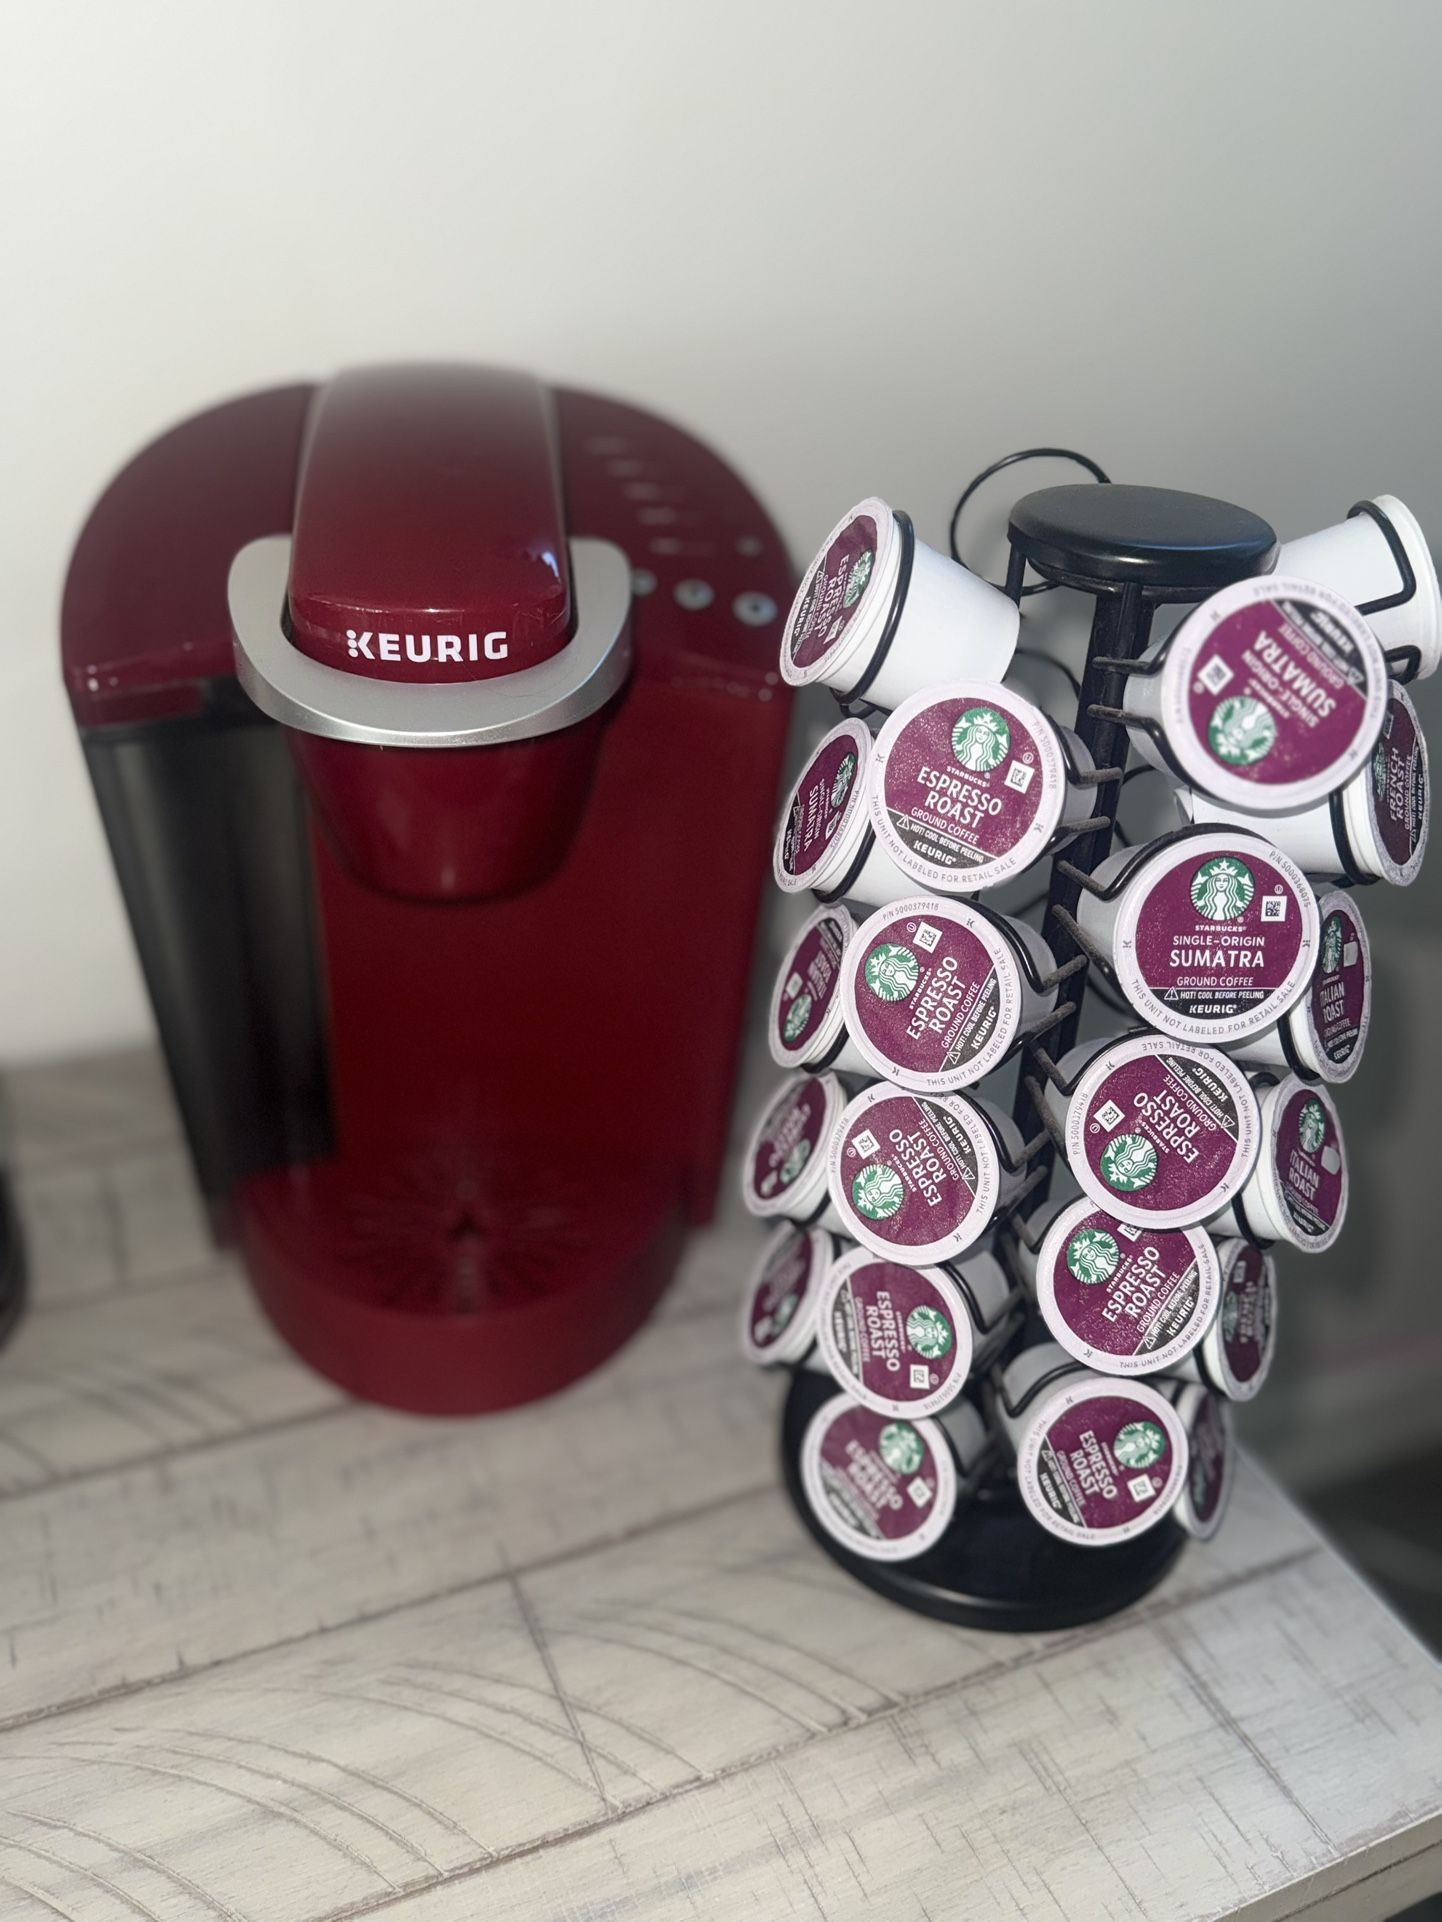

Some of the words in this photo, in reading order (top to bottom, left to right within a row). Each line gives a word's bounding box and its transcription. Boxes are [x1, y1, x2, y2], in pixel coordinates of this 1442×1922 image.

[814, 576, 837, 631] ROAST
[818, 553, 850, 638] ESPRESSO
[794, 596, 811, 637] KEURIG
[346, 630, 508, 662] KEURIG
[1278, 622, 1311, 655] COFFEE
[1253, 631, 1337, 717] SUMATRA
[1306, 651, 1345, 690] GROUND
[1242, 649, 1320, 728] SINGLE-ORIGIN
[917, 767, 1002, 816] ESPRESSO
[946, 766, 988, 787] STARBUCKS
[1389, 747, 1399, 821] FRENCH
[1395, 757, 1405, 820] ROAST
[804, 785, 819, 851] SUMATRA
[911, 807, 947, 830] GROUND
[948, 823, 979, 844] COFFEE
[924, 791, 984, 828] ROAST
[872, 796, 882, 817] THIS
[877, 817, 891, 840] UNIT
[889, 840, 903, 856] NOT
[902, 855, 939, 880] LABELED
[941, 873, 960, 882] FOR
[962, 870, 994, 883] RETAIL
[993, 857, 1016, 875] SALE
[910, 823, 925, 837] HOT!
[924, 829, 940, 843] COOL
[939, 836, 961, 853] BEFORE
[960, 844, 984, 863] PEELING
[914, 840, 954, 865] KEURIG
[1269, 850, 1283, 865] P/N
[882, 911, 894, 921] P/N
[1173, 935, 1265, 946] SINGLE-ORIGIN
[994, 947, 1007, 971] SALE
[1169, 950, 1265, 967] SUMATRA
[909, 970, 930, 1010] STARBUCKS
[1003, 973, 1013, 1006] RETAIL
[1177, 976, 1217, 986] GROUND
[1220, 976, 1254, 986] COFFEE
[1180, 990, 1196, 999] HOT!
[1198, 991, 1213, 999] COOL
[1215, 991, 1237, 999] BEFORE
[1238, 990, 1265, 999] PEELING
[906, 956, 958, 1040] ESPRESSO
[928, 977, 966, 1034] ROAST
[1131, 979, 1145, 999] THIS
[1144, 999, 1162, 1018] UNIT
[1163, 1015, 1182, 1029] NOT
[1183, 1024, 1225, 1035] LABELED
[1228, 1020, 1247, 1033] FOR
[1249, 1005, 1278, 1025] RETAIL
[1277, 980, 1295, 1003] SALE
[1189, 1004, 1233, 1014] KEURIG
[941, 1011, 964, 1049] GROUND
[961, 982, 981, 1013] COFFEE
[955, 1034, 967, 1051] HOT!
[965, 1017, 977, 1036] COOL
[972, 997, 988, 1020] BEFORE
[983, 978, 997, 1000] PEELING
[971, 1009, 997, 1050] KEURIG
[1003, 1008, 1012, 1026] FOR
[983, 1027, 1007, 1063] LABELED
[1142, 1043, 1164, 1051] SALE
[1167, 1041, 1195, 1053] RETAIL
[1198, 1050, 1215, 1062] FOR
[927, 1078, 946, 1086] THIS
[948, 1072, 967, 1084] UNIT
[968, 1060, 985, 1076] NOT
[1165, 1057, 1186, 1078] PEELING
[1215, 1061, 1243, 1092] LABELED
[1163, 1075, 1189, 1101] COFFEE
[1183, 1076, 1200, 1094] BEFORE
[1195, 1068, 1229, 1103] KEURIG
[1199, 1094, 1213, 1107] COOL
[922, 1101, 939, 1125] PEELING
[949, 1101, 964, 1114] FOR
[1153, 1089, 1201, 1138] ROAST
[1186, 1100, 1217, 1131] GROUND
[1212, 1106, 1224, 1119] HOT!
[1238, 1092, 1247, 1112] NOT
[918, 1119, 939, 1147] COFFEE
[936, 1124, 951, 1144] BEFORE
[948, 1122, 972, 1154] KEURIG
[964, 1114, 985, 1151] LABELED
[1134, 1092, 1200, 1164] ESPRESSO
[1144, 1123, 1170, 1154] STARBUCKS
[1242, 1113, 1251, 1138] UNIT
[907, 1131, 947, 1185] ROAST
[948, 1144, 958, 1157] COOL
[954, 1157, 965, 1170] HOT!
[981, 1151, 990, 1168] NOT
[1073, 1140, 1081, 1155] P/N
[1241, 1138, 1251, 1158] THIS
[888, 1129, 943, 1207] ESPRESSO
[895, 1159, 917, 1192] STARBUCKS
[937, 1148, 960, 1180] GROUND
[1290, 1149, 1320, 1189] ITALIAN
[982, 1175, 991, 1195] UNIT
[1288, 1166, 1316, 1200] ROAST
[976, 1195, 988, 1214] THIS
[1200, 1244, 1210, 1264] SALE
[1102, 1246, 1160, 1323] ESPRESSO
[1106, 1261, 1130, 1293] STARBUCKS
[1124, 1264, 1166, 1318] ROAST
[1204, 1267, 1212, 1295] RETAIL
[1137, 1298, 1161, 1333] GROUND
[1159, 1272, 1180, 1300] COFFEE
[1160, 1306, 1171, 1322] COOL
[1166, 1299, 1194, 1337] KEURIG
[1200, 1298, 1208, 1315] FOR
[865, 1305, 886, 1359] ROAST
[877, 1291, 900, 1372] ESPRESSO
[1177, 1316, 1203, 1347] LABELED
[1141, 1356, 1160, 1367] UNIT
[1162, 1347, 1176, 1358] NOT
[846, 1440, 903, 1510] ESPRESSO
[1056, 1450, 1073, 1483] GROUND
[1068, 1480, 1087, 1508] COFFEE
[1069, 1449, 1101, 1495] ROAST
[1079, 1430, 1118, 1499] ESPRESSO
[1039, 1472, 1062, 1509] KEURIG
